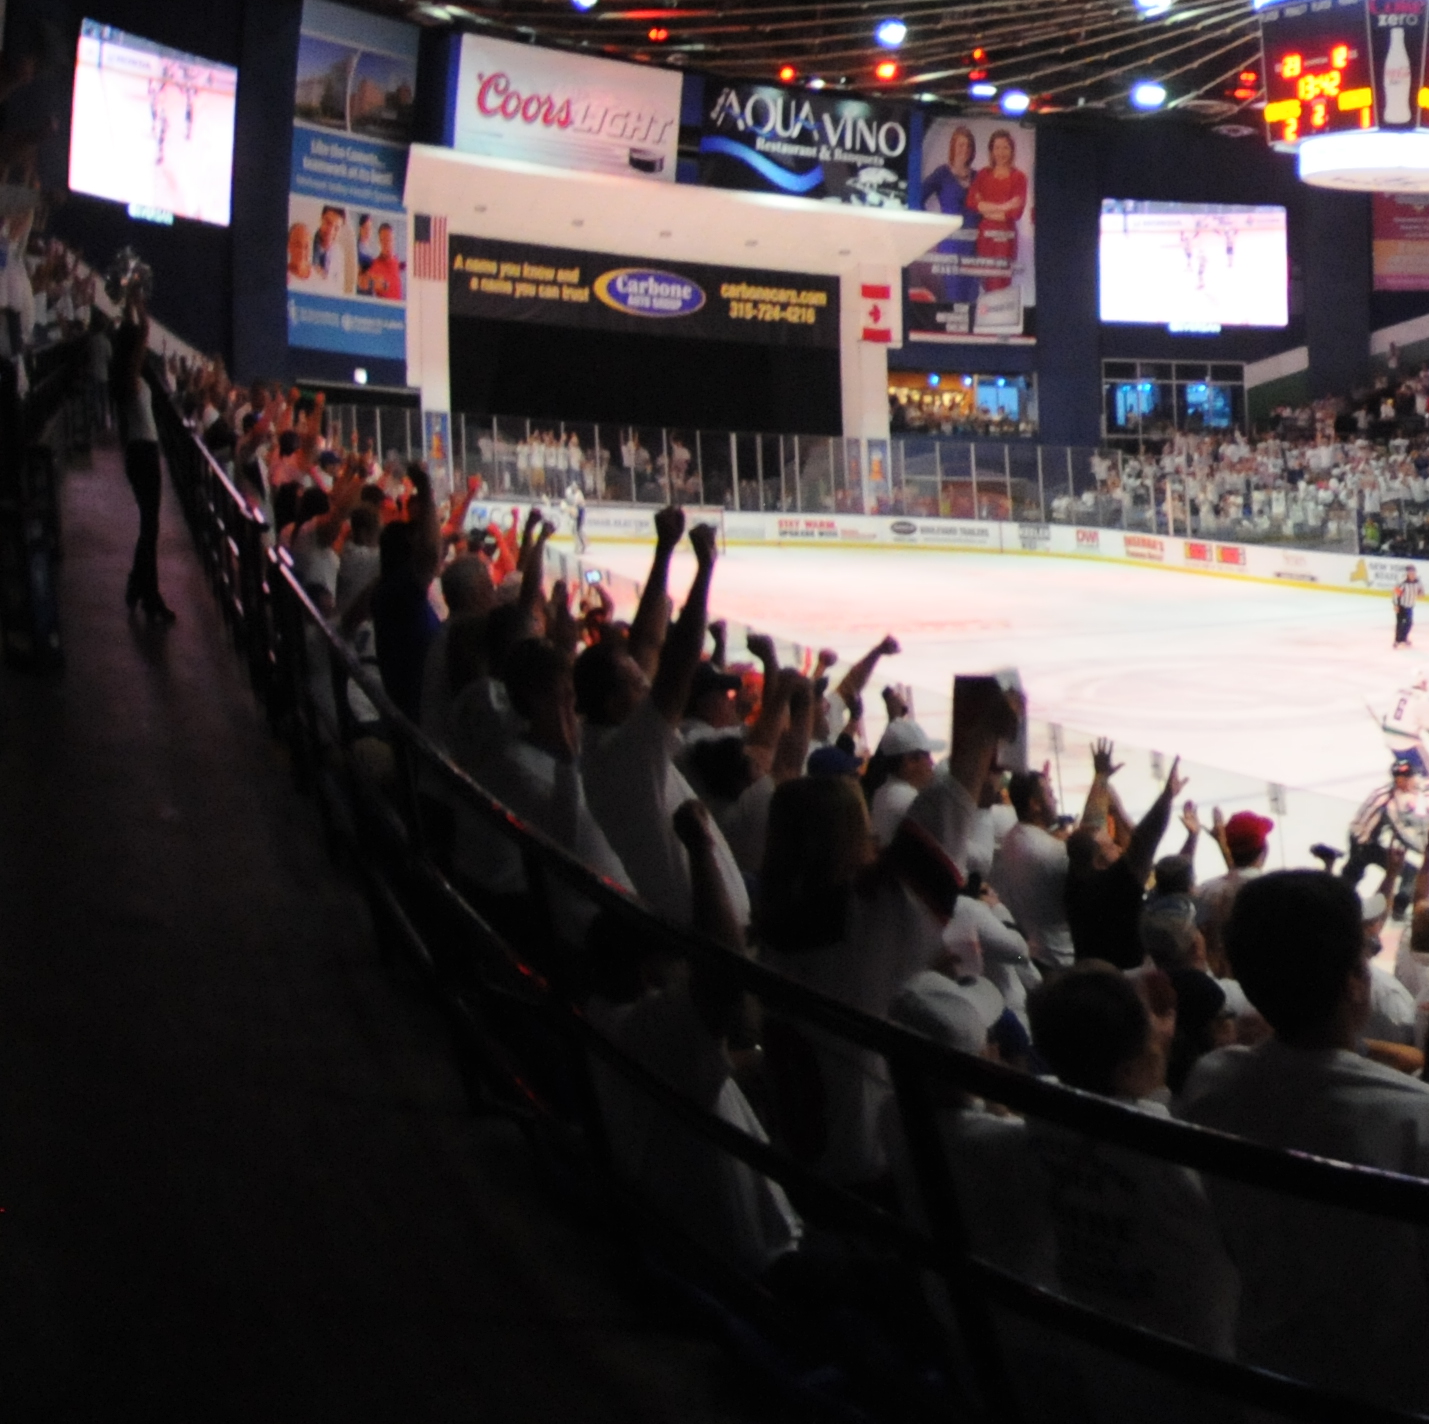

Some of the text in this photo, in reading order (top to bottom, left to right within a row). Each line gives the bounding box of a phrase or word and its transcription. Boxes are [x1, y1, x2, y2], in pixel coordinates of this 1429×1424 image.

[1377, 13, 1419, 26] zero
[1298, 70, 1342, 102] 13:42
[476, 71, 676, 145] Coors LIGHT
[1311, 102, 1326, 127] 2
[1360, 107, 1371, 129] 1
[1283, 117, 1299, 143] 2
[755, 136, 818, 158] Restaurant
[499, 260, 521, 280] you
[556, 265, 580, 283] and
[514, 280, 537, 299] you
[615, 273, 693, 301] Carbone
